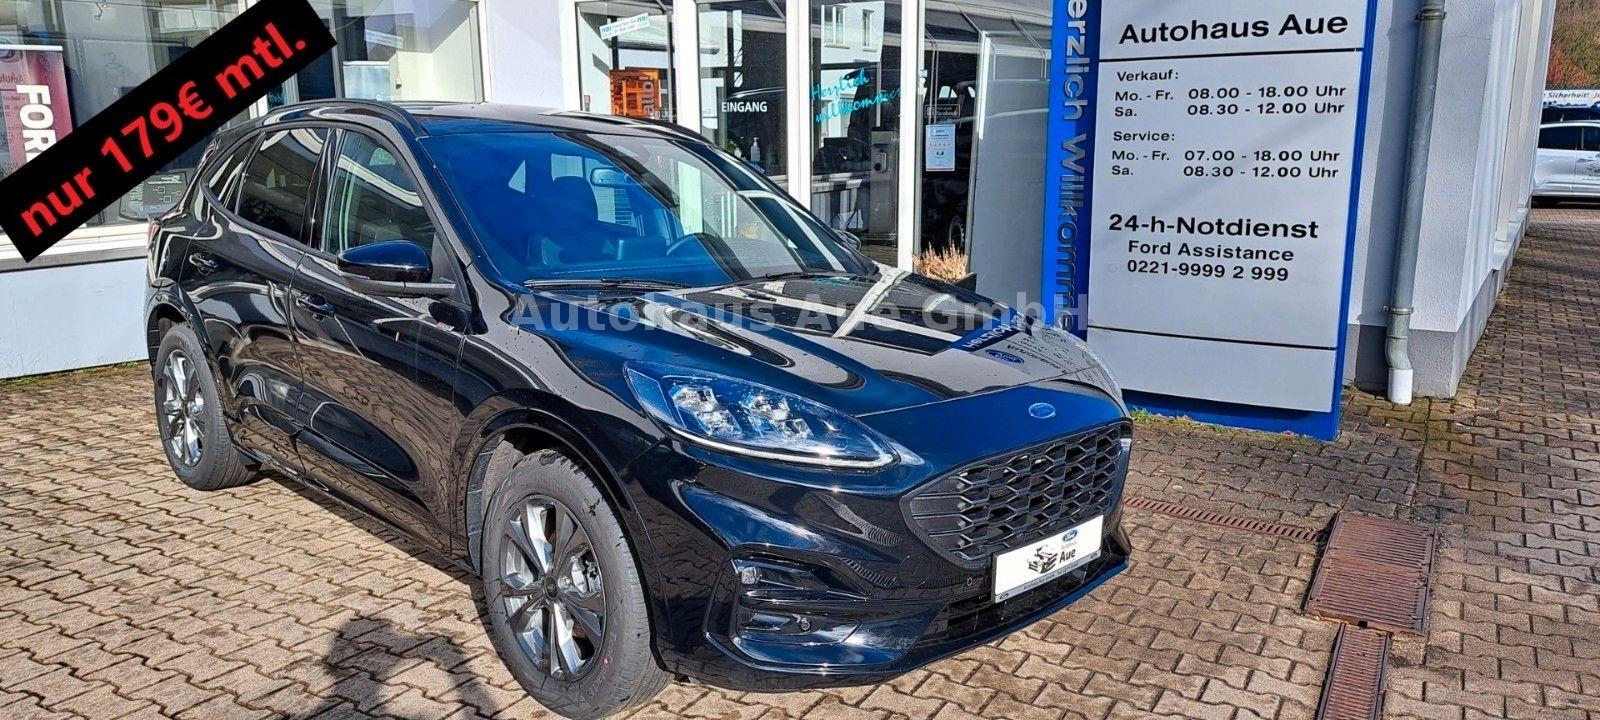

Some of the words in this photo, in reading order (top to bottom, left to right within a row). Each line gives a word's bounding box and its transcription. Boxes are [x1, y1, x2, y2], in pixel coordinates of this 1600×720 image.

[1118, 20, 1270, 45] Autohaus
[1278, 14, 1348, 36] Aue
[1116, 69, 1178, 82] Verkauf:
[1114, 91, 1142, 101] Mo.
[1155, 90, 1174, 100] Fr.
[1188, 87, 1240, 99] 08.00
[1258, 86, 1308, 98] 18.00
[1315, 85, 1347, 97] Uhr
[721, 101, 768, 113] EINGANG
[1114, 106, 1138, 117] Sa.
[1187, 103, 1239, 115] 08.30
[1257, 102, 1307, 114] 12.00
[1314, 102, 1345, 113] Uhr
[1113, 130, 1175, 141] Service:
[1111, 150, 1139, 160] Mo.
[1151, 150, 1170, 160] Fr.
[1184, 150, 1235, 161] 07.00
[1253, 150, 1303, 161] 18.00
[1310, 150, 1341, 161] Uhr
[1111, 165, 1134, 176] Sa.
[1183, 165, 1234, 177] 08.30
[1252, 166, 1301, 177] 12.00
[1308, 166, 1339, 178] Uhr
[1108, 213, 1319, 239] 24-h-Notdienst
[1128, 240, 1172, 255] Ford
[1178, 242, 1295, 262] Assistance
[1127, 259, 1226, 278] 0221-9999
[1232, 265, 1244, 279] 2
[1251, 266, 1289, 281] 999
[1059, 548, 1077, 564] Aue
